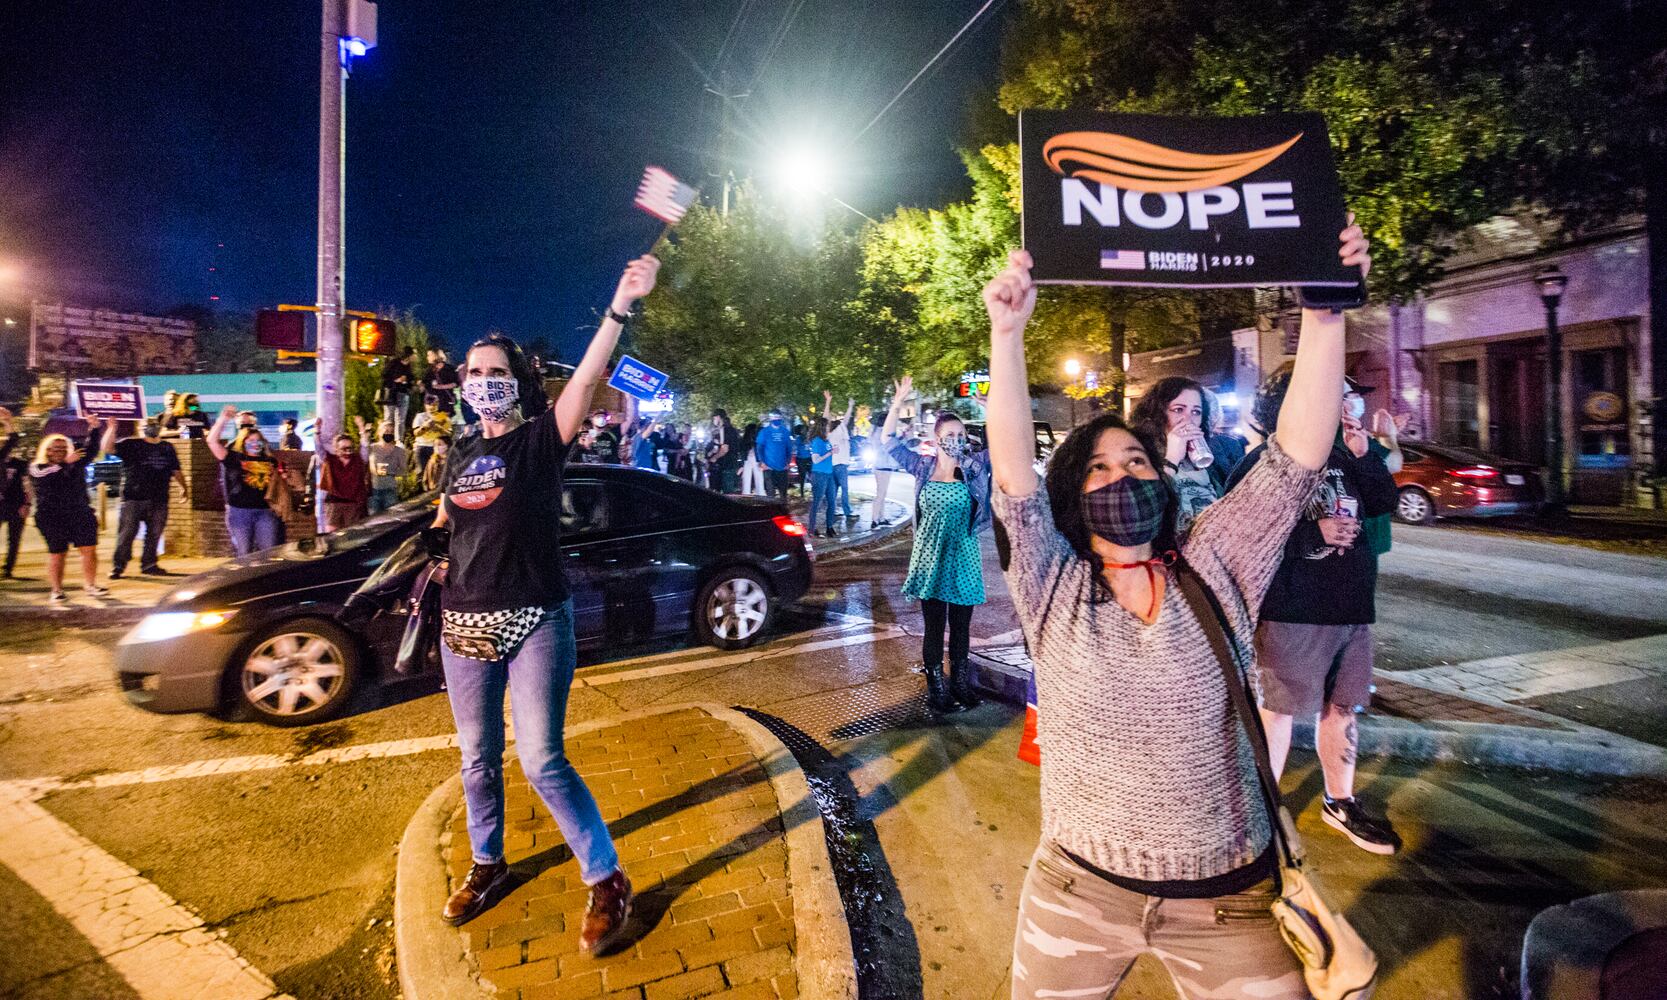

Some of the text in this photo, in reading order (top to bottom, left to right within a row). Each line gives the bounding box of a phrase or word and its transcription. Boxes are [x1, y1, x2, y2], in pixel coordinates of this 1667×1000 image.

[1061, 178, 1301, 230] NOPE
[1148, 251, 1199, 264] BIDEN
[1211, 254, 1255, 267] 2020
[1150, 262, 1198, 272] HARRIS
[622, 364, 660, 387] BIDEN
[487, 381, 515, 390] BIDEN
[83, 391, 136, 402] BIDEN
[453, 467, 506, 487] BIDEN
